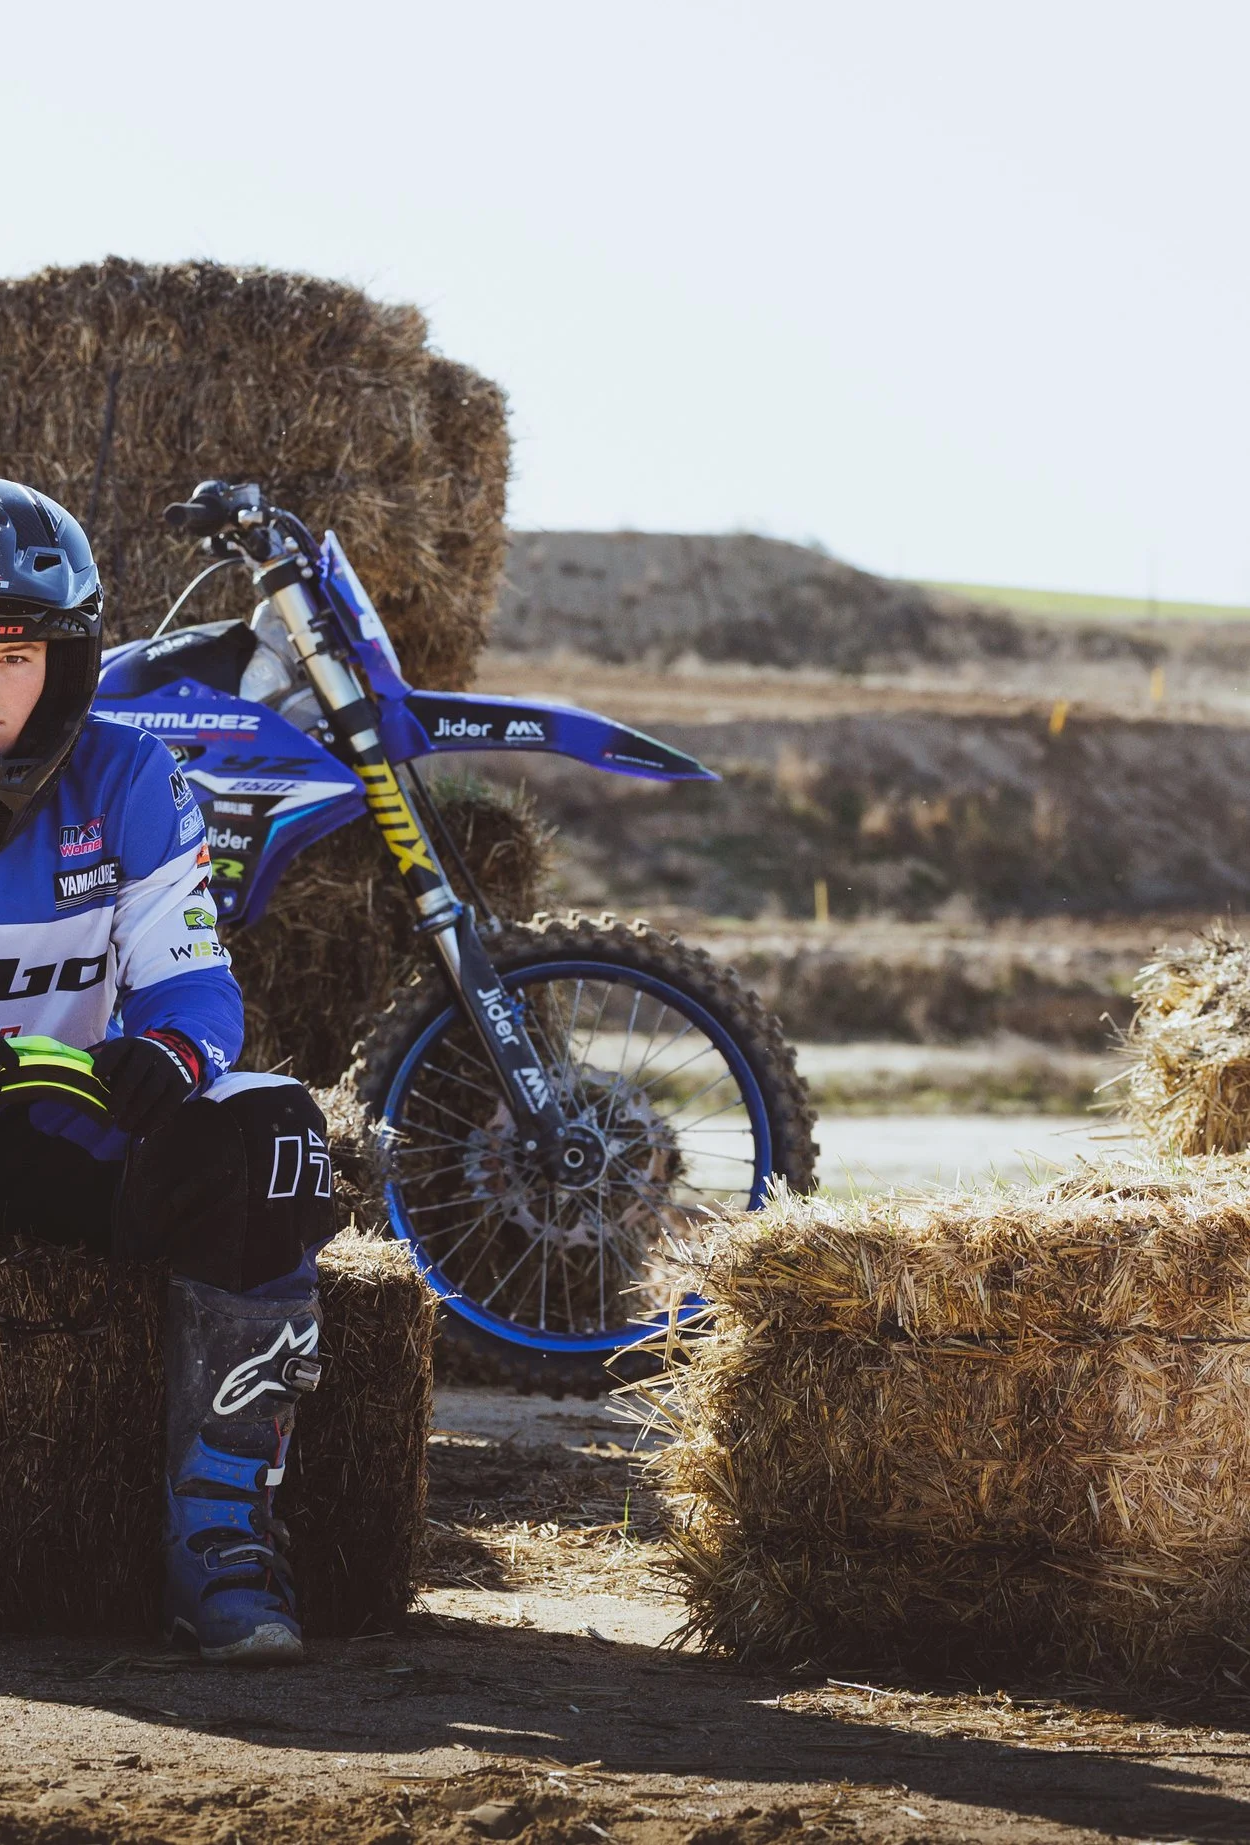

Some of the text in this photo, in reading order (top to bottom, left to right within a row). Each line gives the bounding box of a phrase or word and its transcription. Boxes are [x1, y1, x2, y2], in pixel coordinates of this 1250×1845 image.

[434, 718, 544, 737] Jider MX
[58, 862, 117, 897] YAMALUBE
[476, 987, 520, 1046] Jider
